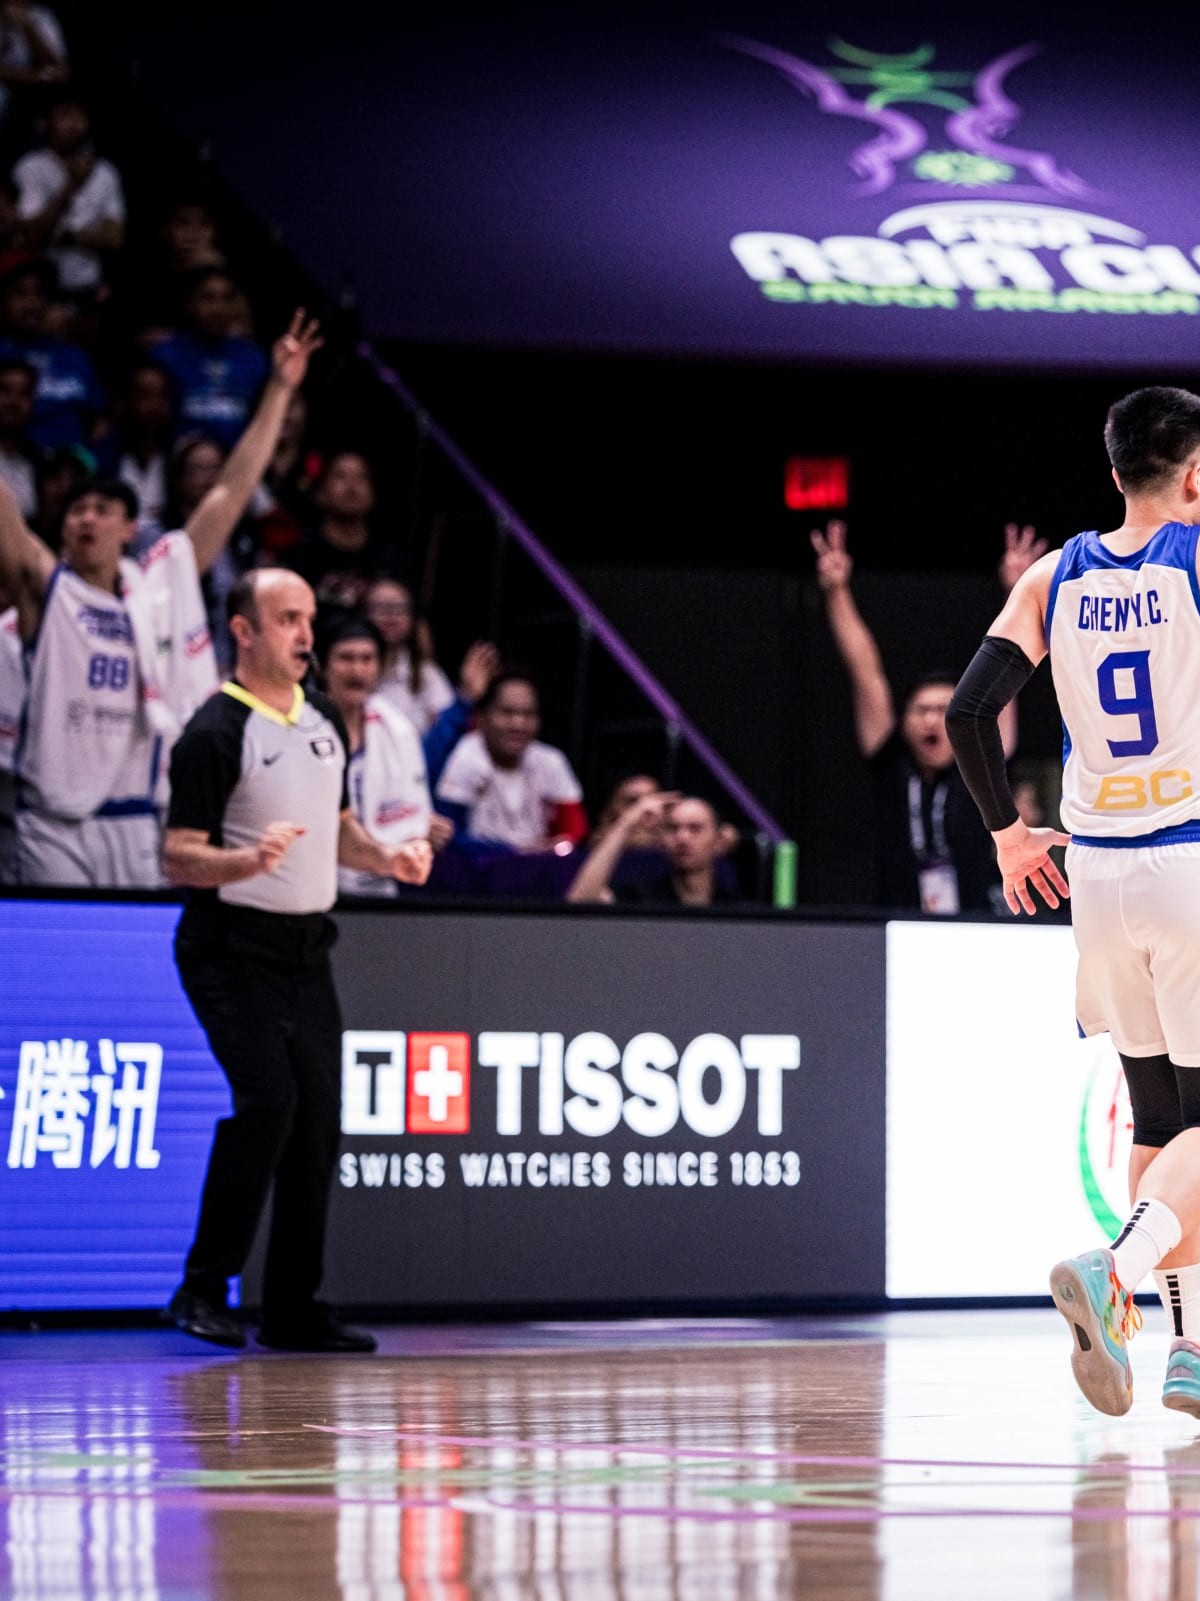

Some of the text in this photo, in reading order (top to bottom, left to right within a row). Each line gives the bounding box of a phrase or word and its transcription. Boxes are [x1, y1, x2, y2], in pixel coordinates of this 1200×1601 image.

[730, 233, 1055, 289] ASIA
[87, 653, 130, 691] 88
[1096, 650, 1160, 758] 9
[1092, 769, 1194, 810] BC
[7, 1038, 164, 1169] 腾讯
[477, 1031, 802, 1137] TISSOT
[339, 1150, 802, 1188] SWISS WATCHES SINCE 1853
